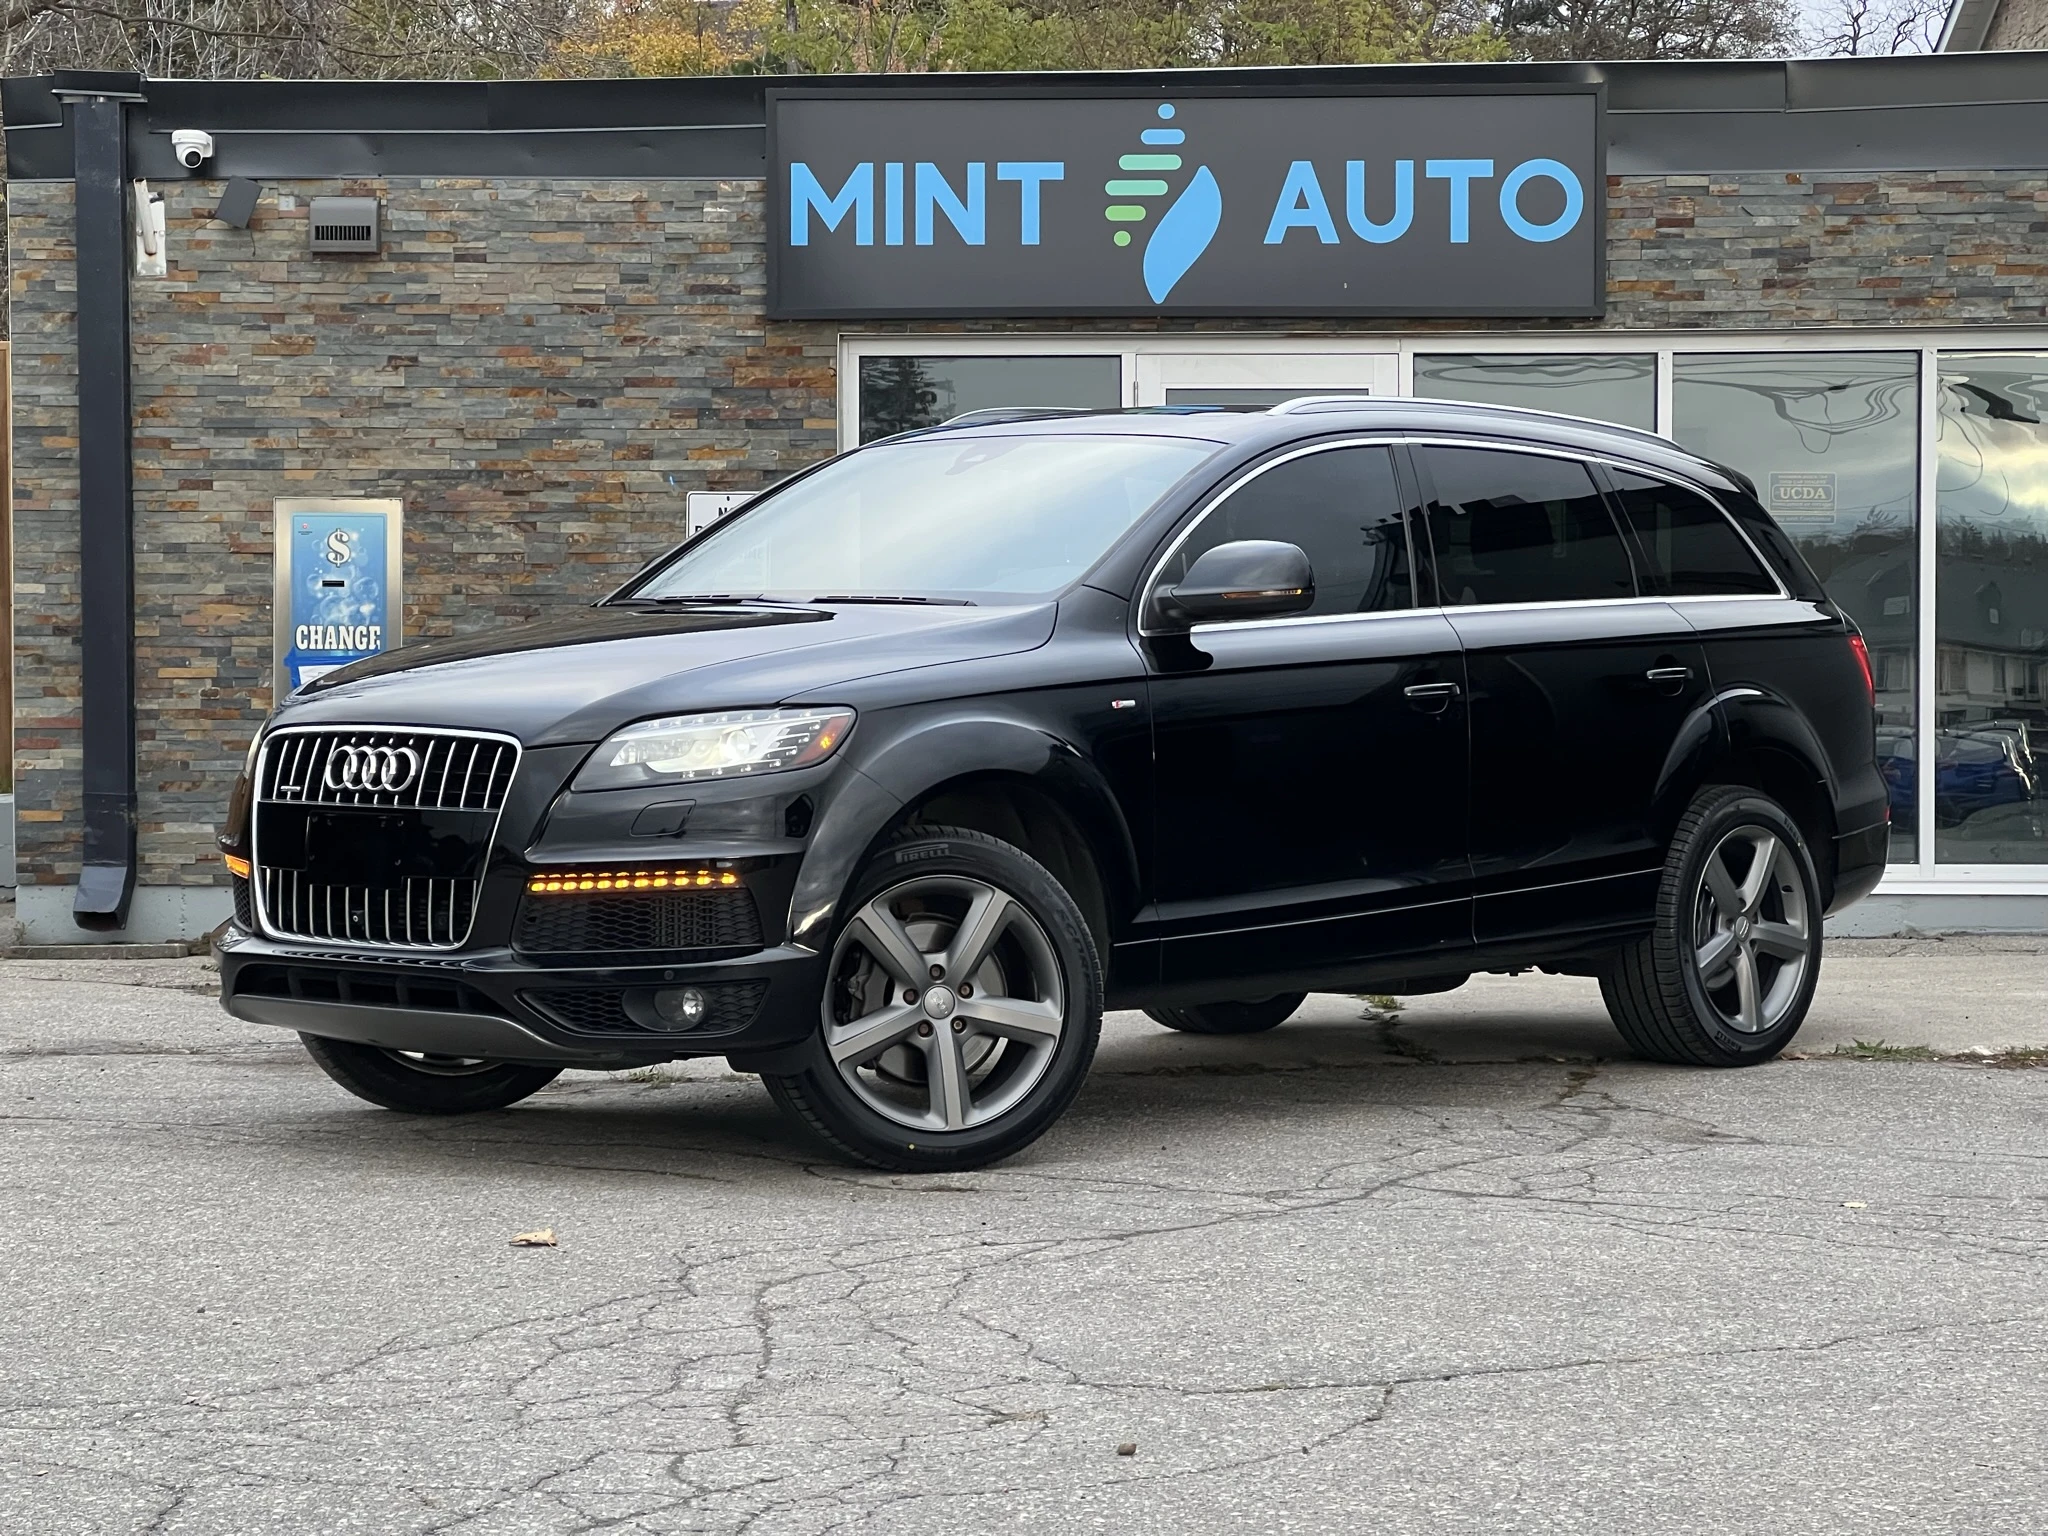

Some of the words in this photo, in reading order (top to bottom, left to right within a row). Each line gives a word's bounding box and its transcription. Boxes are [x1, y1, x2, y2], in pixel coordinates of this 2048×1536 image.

[790, 161, 1065, 246] MINT
[1263, 158, 1584, 245] AUTO
[1779, 486, 1827, 500] UCDA
[326, 528, 351, 568] $
[295, 624, 381, 651] CHANGE
[894, 843, 950, 864] PIRELLI
